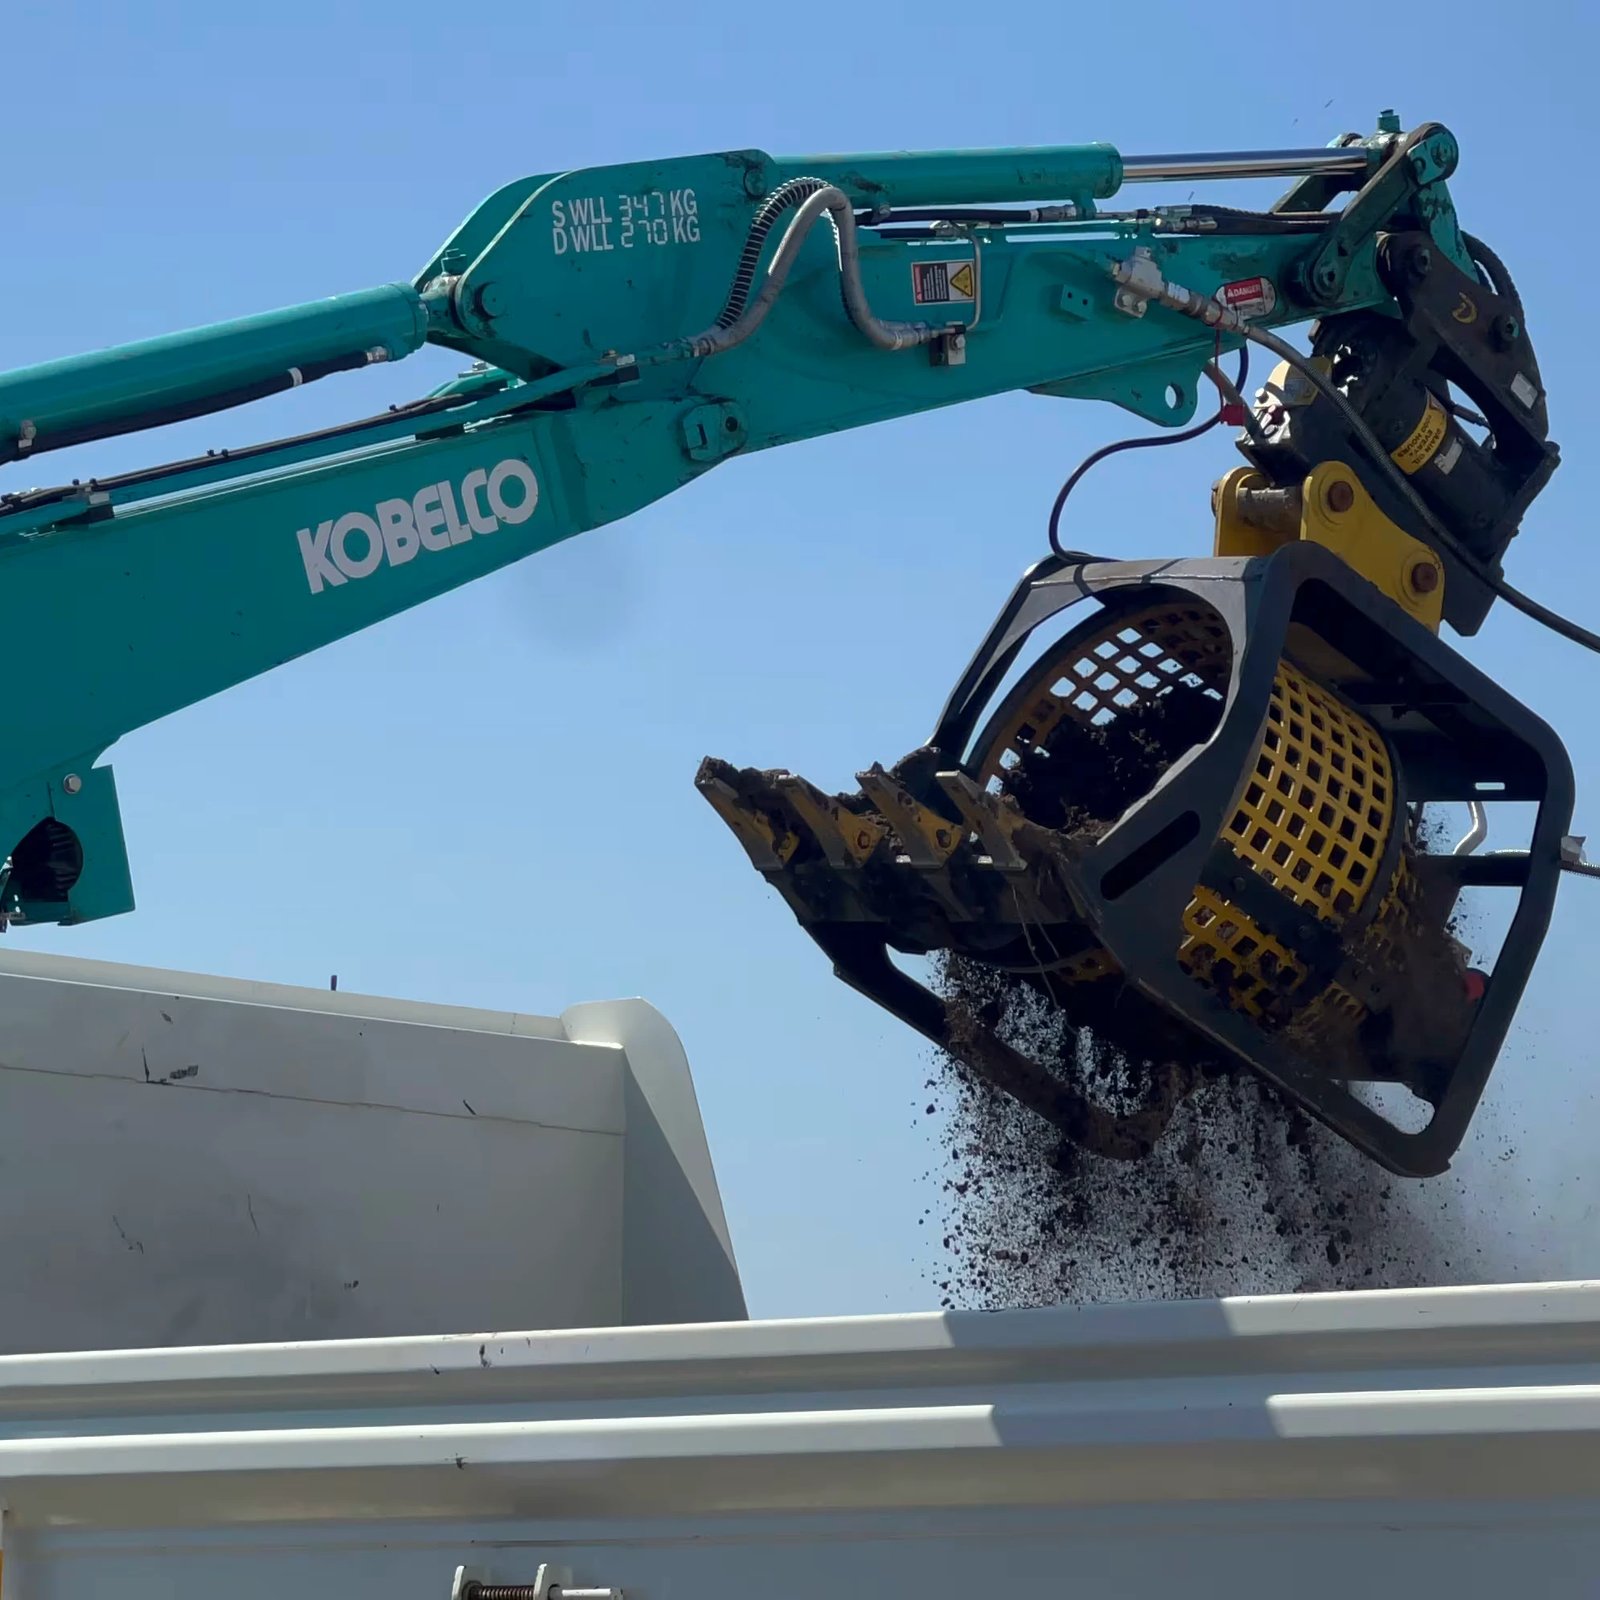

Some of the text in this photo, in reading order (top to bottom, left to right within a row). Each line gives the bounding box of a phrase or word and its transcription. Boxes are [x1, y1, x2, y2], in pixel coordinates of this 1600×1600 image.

[552, 188, 698, 228] S WLL 347 KG
[553, 215, 701, 255] D WLL 270 KG
[1233, 283, 1263, 298] DANGER
[296, 458, 539, 595] KOBELCO
